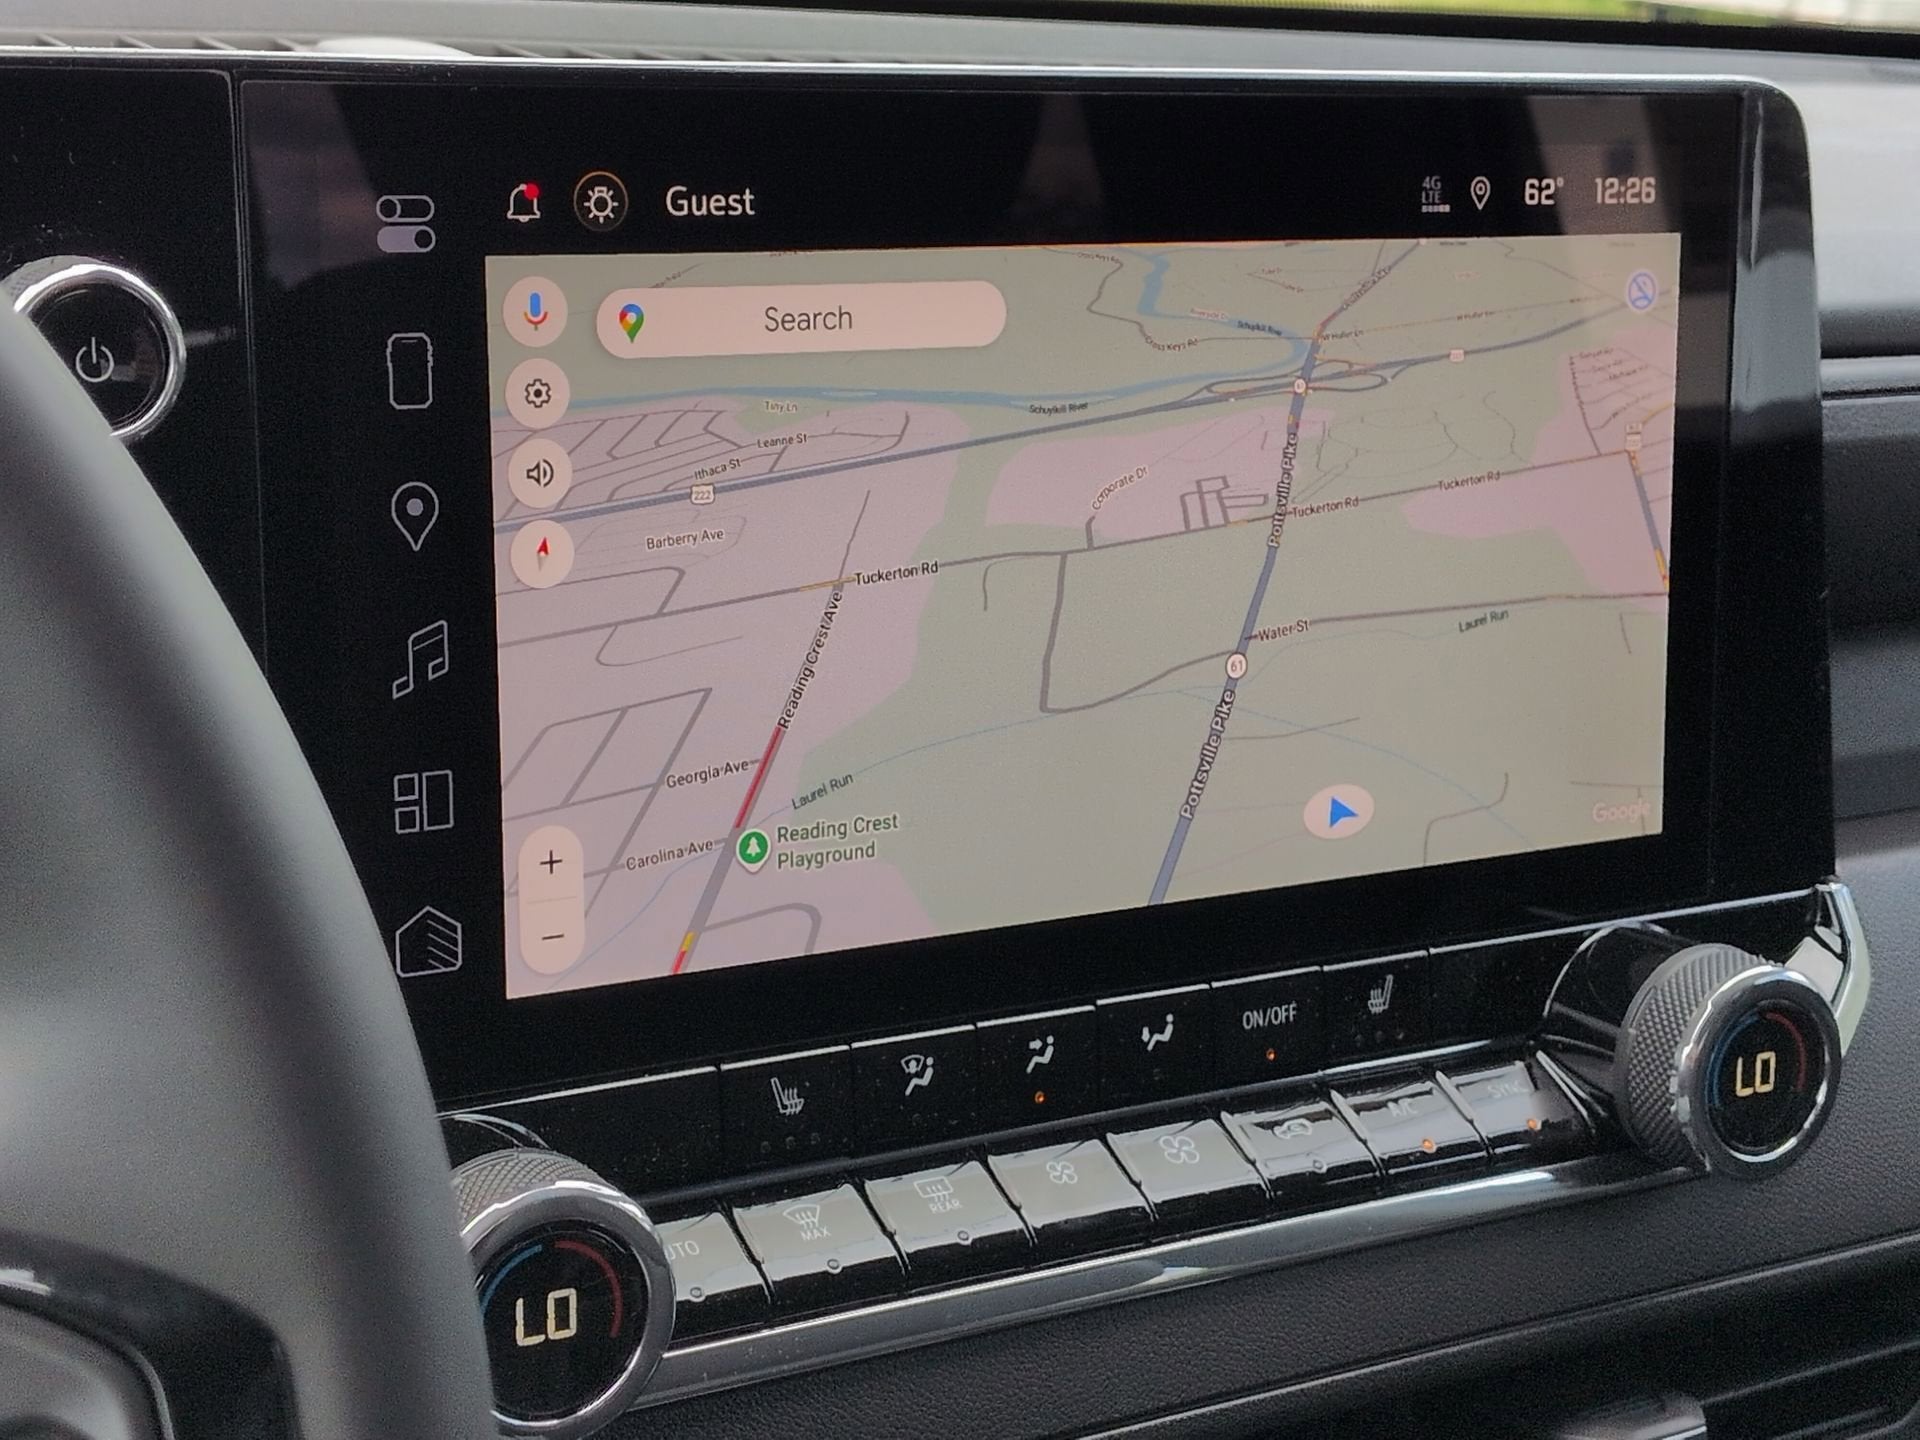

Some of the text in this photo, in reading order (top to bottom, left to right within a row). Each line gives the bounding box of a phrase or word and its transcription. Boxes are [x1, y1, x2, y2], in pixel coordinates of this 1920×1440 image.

[1422, 176, 1441, 190] 4G
[1595, 177, 1657, 204] 12:26
[665, 186, 756, 216] Guest
[1422, 191, 1441, 204] LTE
[764, 306, 853, 332] Search
[757, 433, 808, 448] Leanne St
[694, 459, 742, 480] Ithaca St
[1438, 470, 1500, 491] Tuckerton Rd
[693, 490, 712, 500] 222
[1267, 432, 1297, 548] Pottsville Pike
[1292, 497, 1359, 518] Tuckerton Rd
[646, 530, 724, 550] Barberry Ave
[854, 562, 939, 586] Tuckerton Rd
[1259, 620, 1309, 641] Water St
[1459, 609, 1508, 632] Laurel Run
[777, 592, 843, 729] Reading Crest Ave
[1231, 660, 1243, 672] 61
[1180, 690, 1236, 820] Pottsville Pike
[666, 759, 749, 789] Georgia Ave
[791, 773, 853, 810] Laurel Run
[777, 814, 898, 844] Reading Crest
[626, 839, 713, 871] Carolina Ave
[777, 841, 876, 869] Playground
[1242, 1002, 1297, 1030] ON/OFF
[1736, 1051, 1776, 1097] LO
[1387, 1098, 1418, 1118] A/C
[929, 1200, 962, 1214] REAR
[801, 1227, 831, 1242] MAX
[666, 1240, 700, 1262] UTO
[515, 1287, 577, 1347] LO
